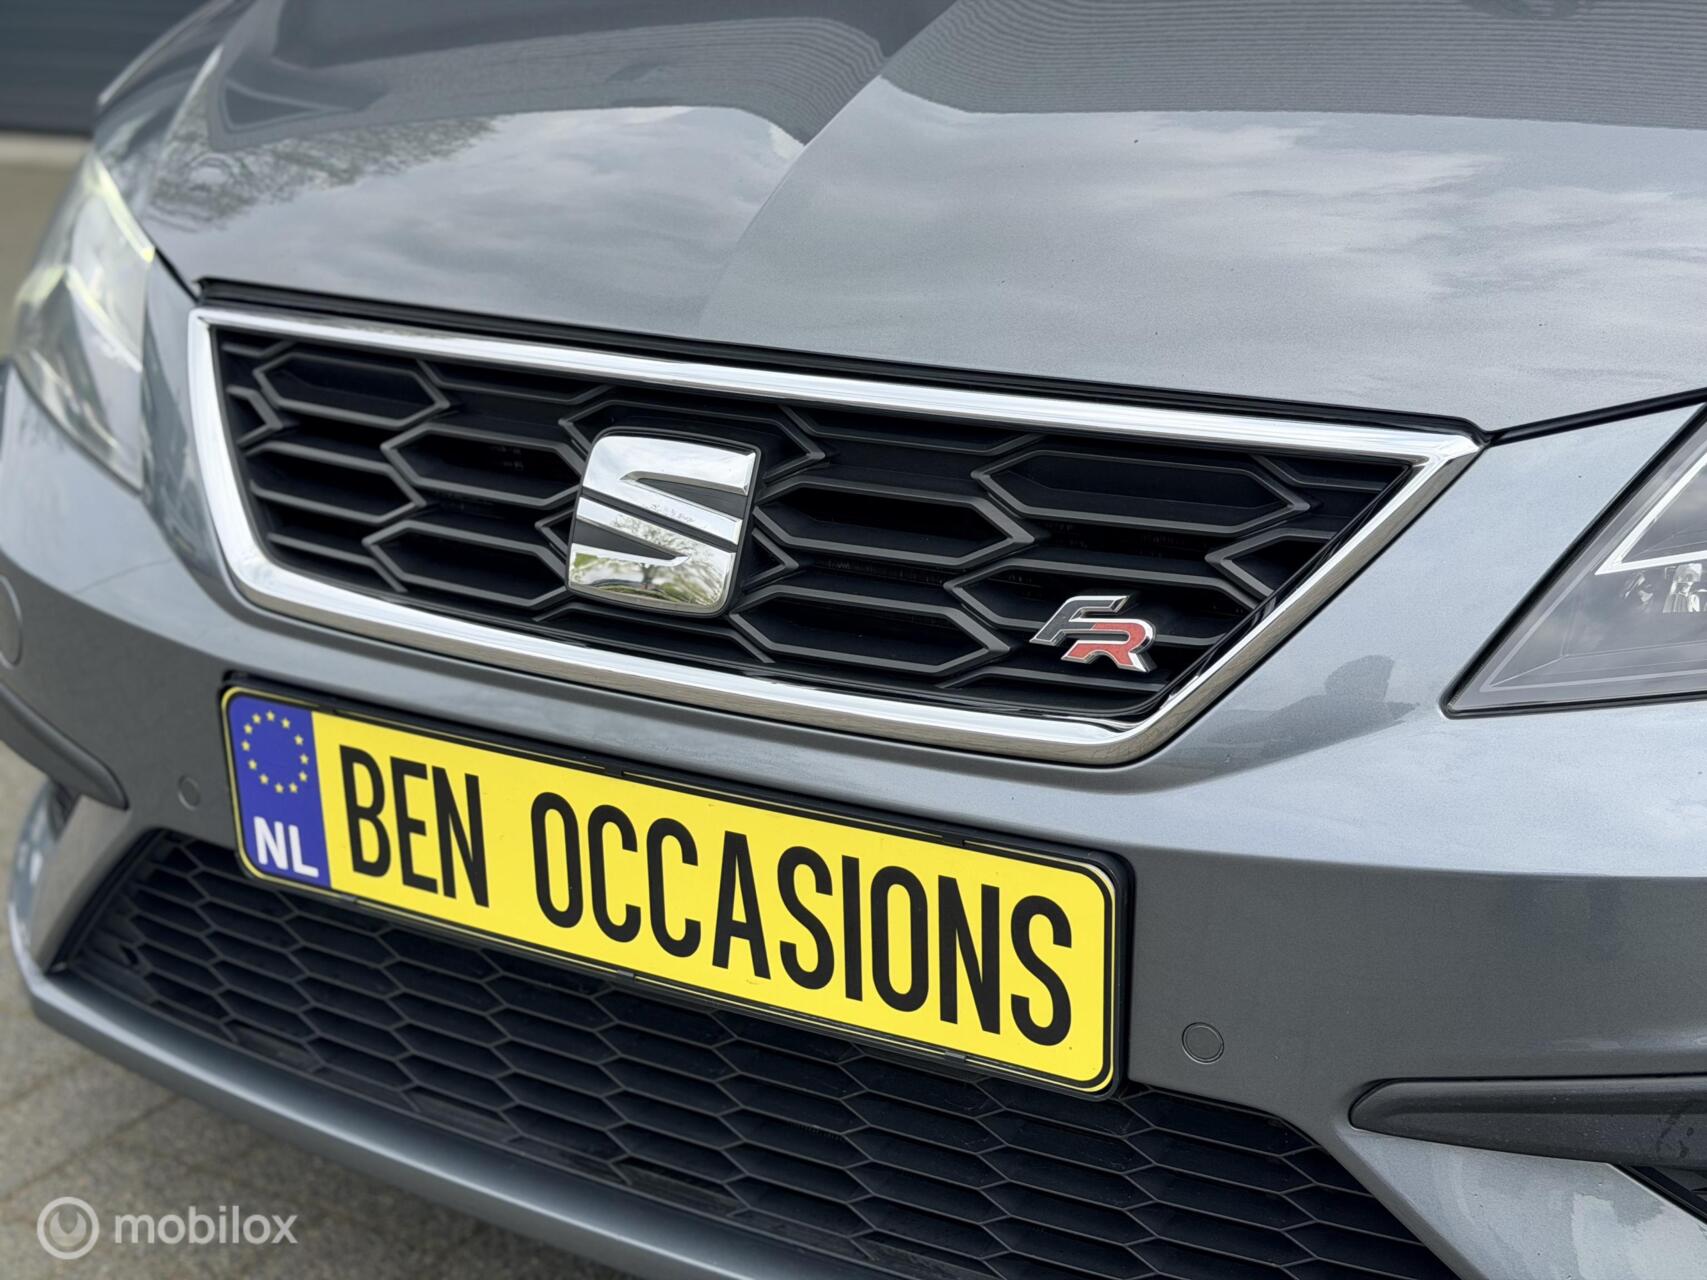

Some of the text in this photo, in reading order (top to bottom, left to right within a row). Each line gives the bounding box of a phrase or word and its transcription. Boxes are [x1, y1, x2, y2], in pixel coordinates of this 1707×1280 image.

[1029, 594, 1157, 673] FR
[253, 816, 319, 878] NL
[339, 744, 1072, 1046] BEN OCCASIONS
